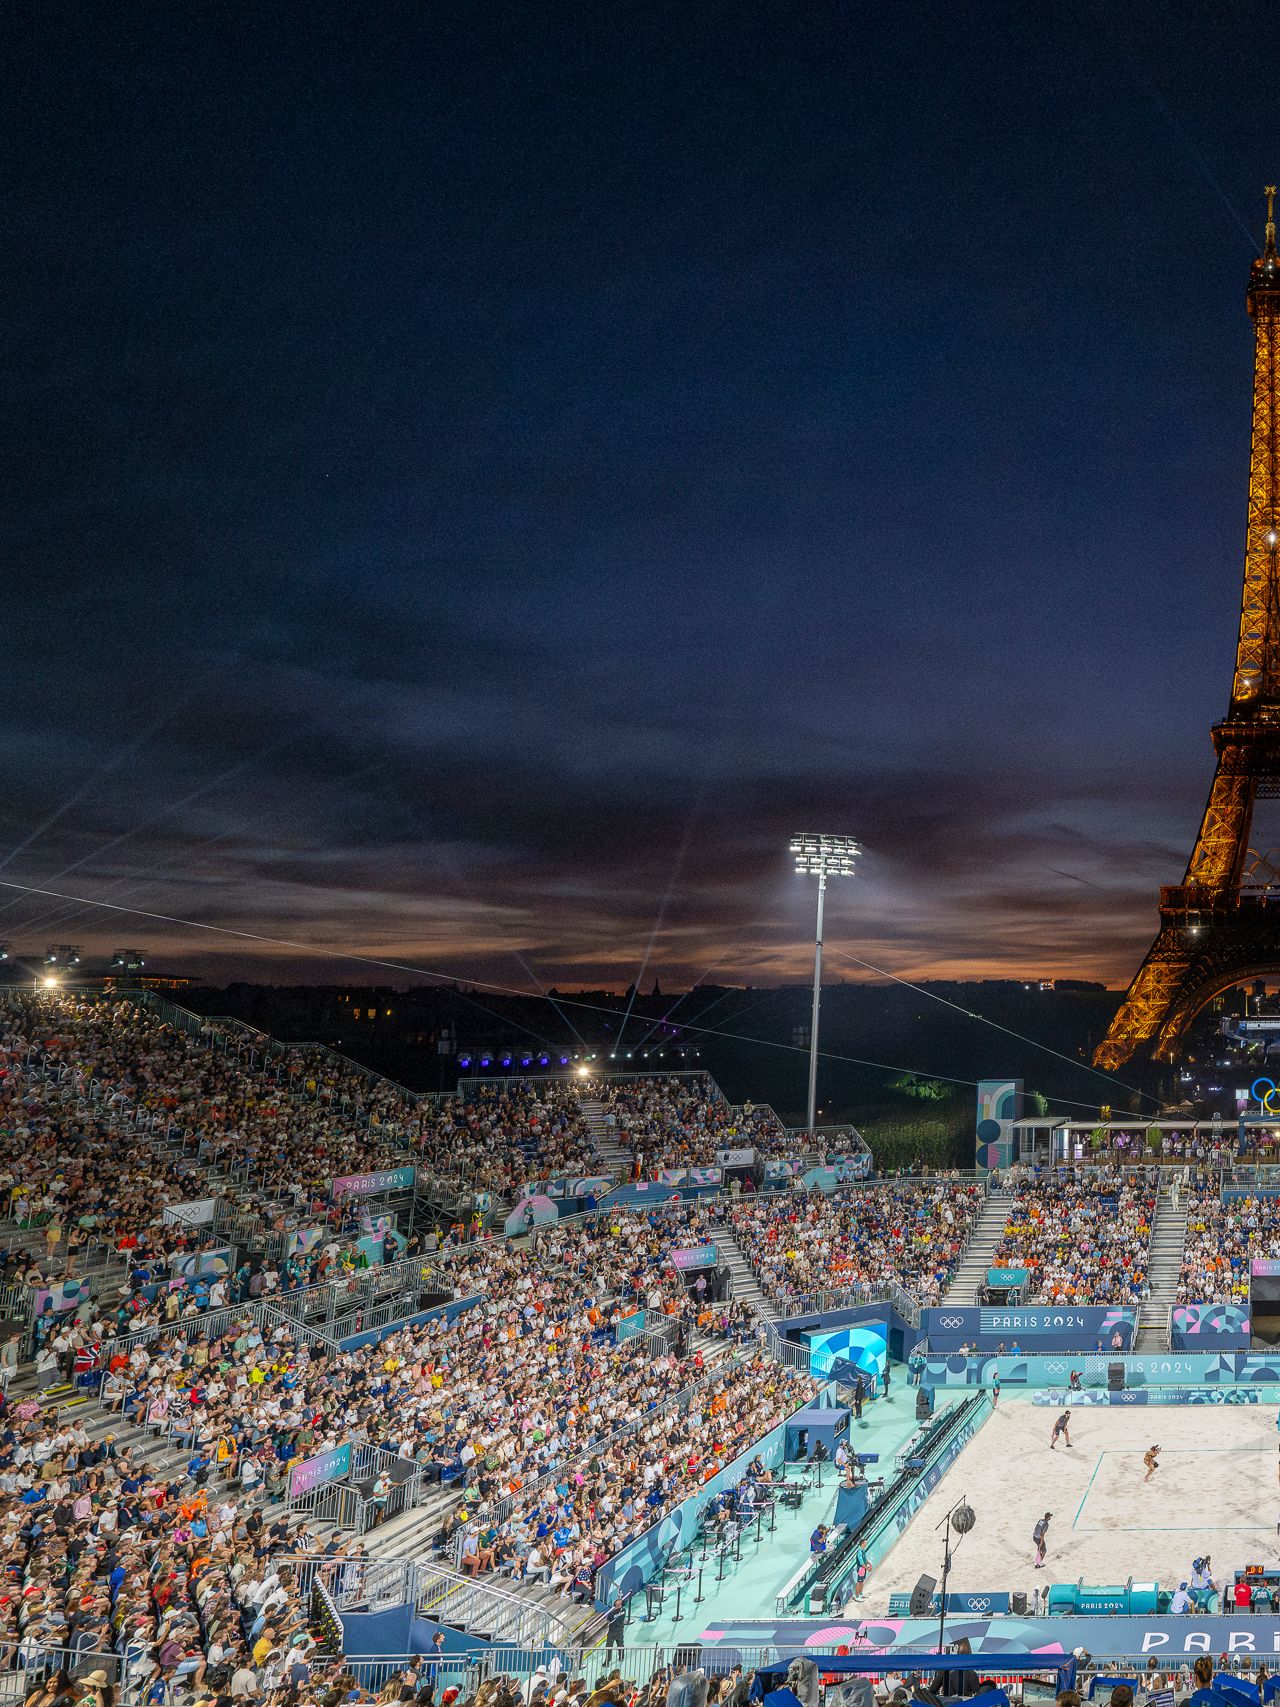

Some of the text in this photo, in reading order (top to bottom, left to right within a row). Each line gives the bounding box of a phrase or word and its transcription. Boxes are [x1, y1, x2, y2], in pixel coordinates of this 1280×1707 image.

[346, 1174, 404, 1190] PARIS 2024
[993, 1316, 1084, 1327] PARIS 2024
[1098, 1362, 1192, 1373] PIS 2024
[324, 1456, 346, 1472] 2024
